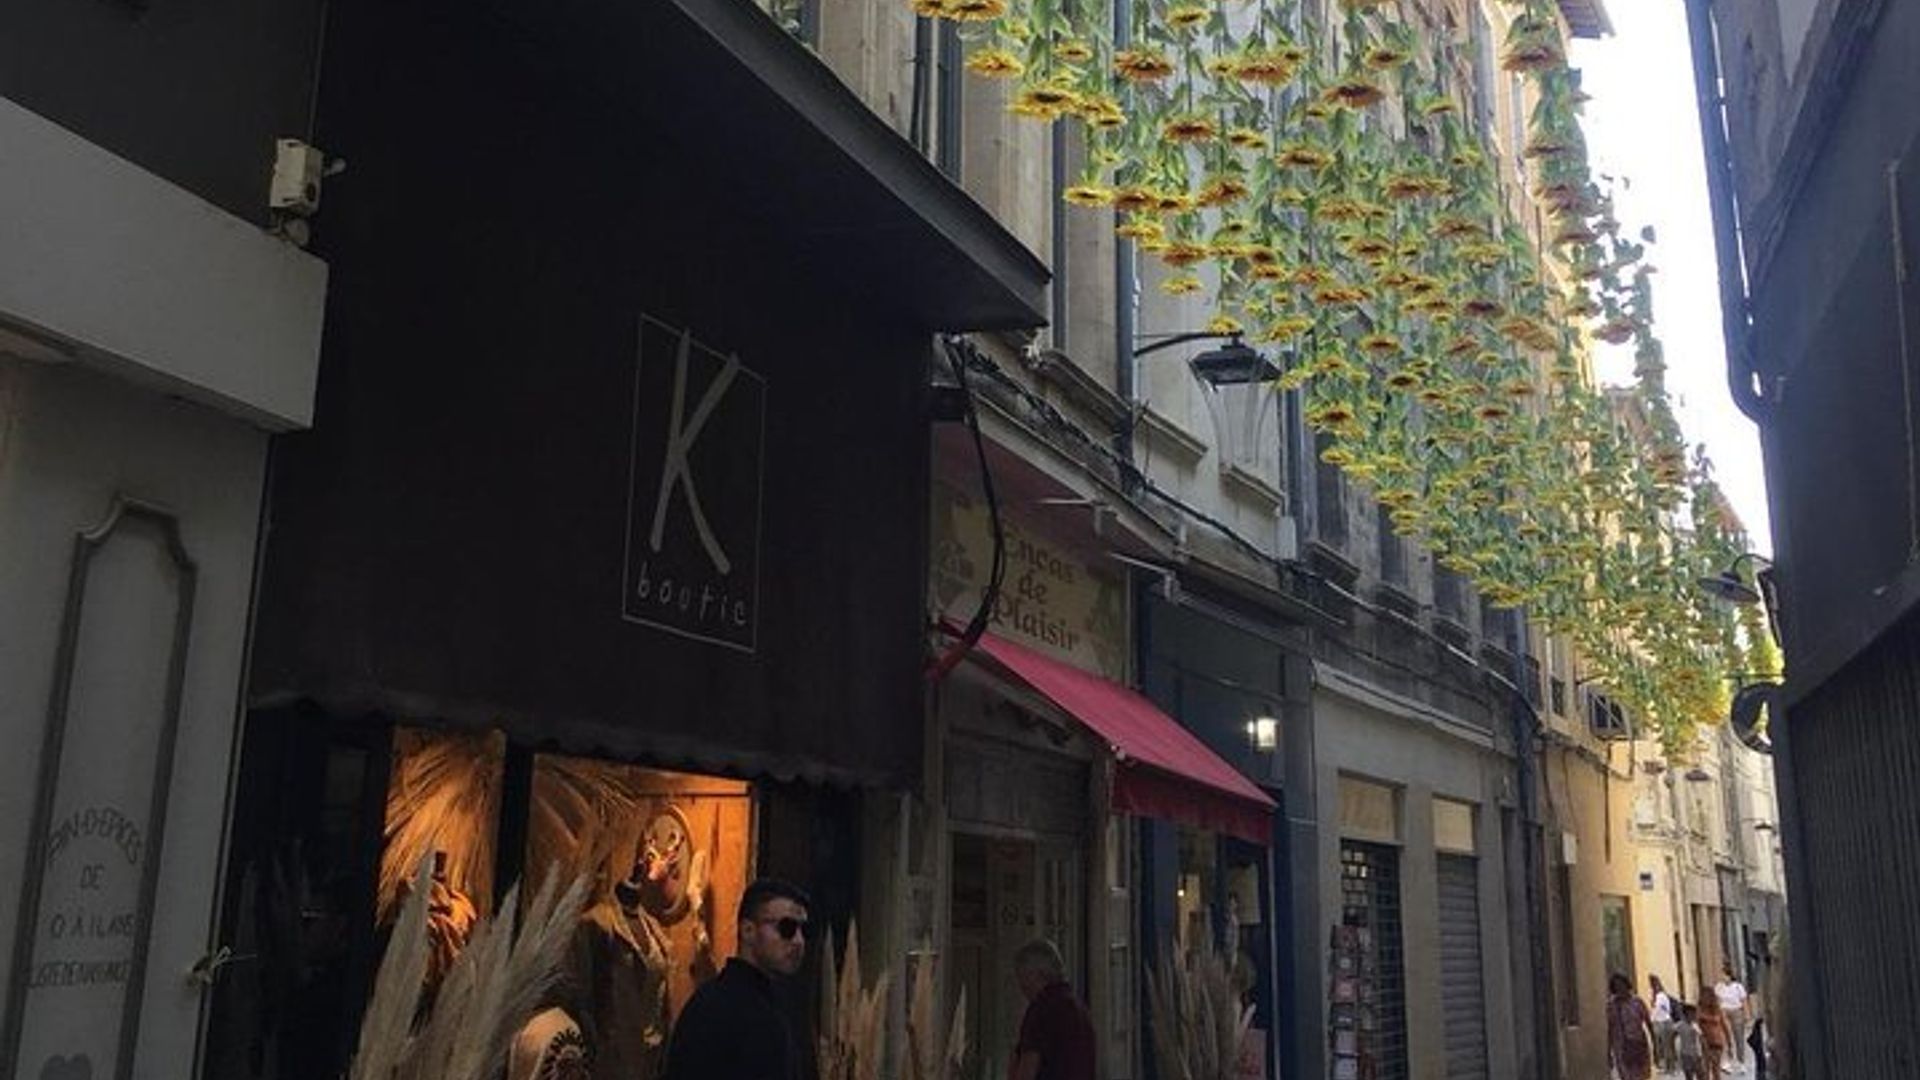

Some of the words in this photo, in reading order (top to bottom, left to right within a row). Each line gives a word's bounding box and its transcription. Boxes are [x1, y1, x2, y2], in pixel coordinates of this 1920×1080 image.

[650, 328, 740, 574] K
[1018, 569, 1048, 604] de
[992, 592, 1080, 651] Plaisir
[80, 865, 104, 890] DE
